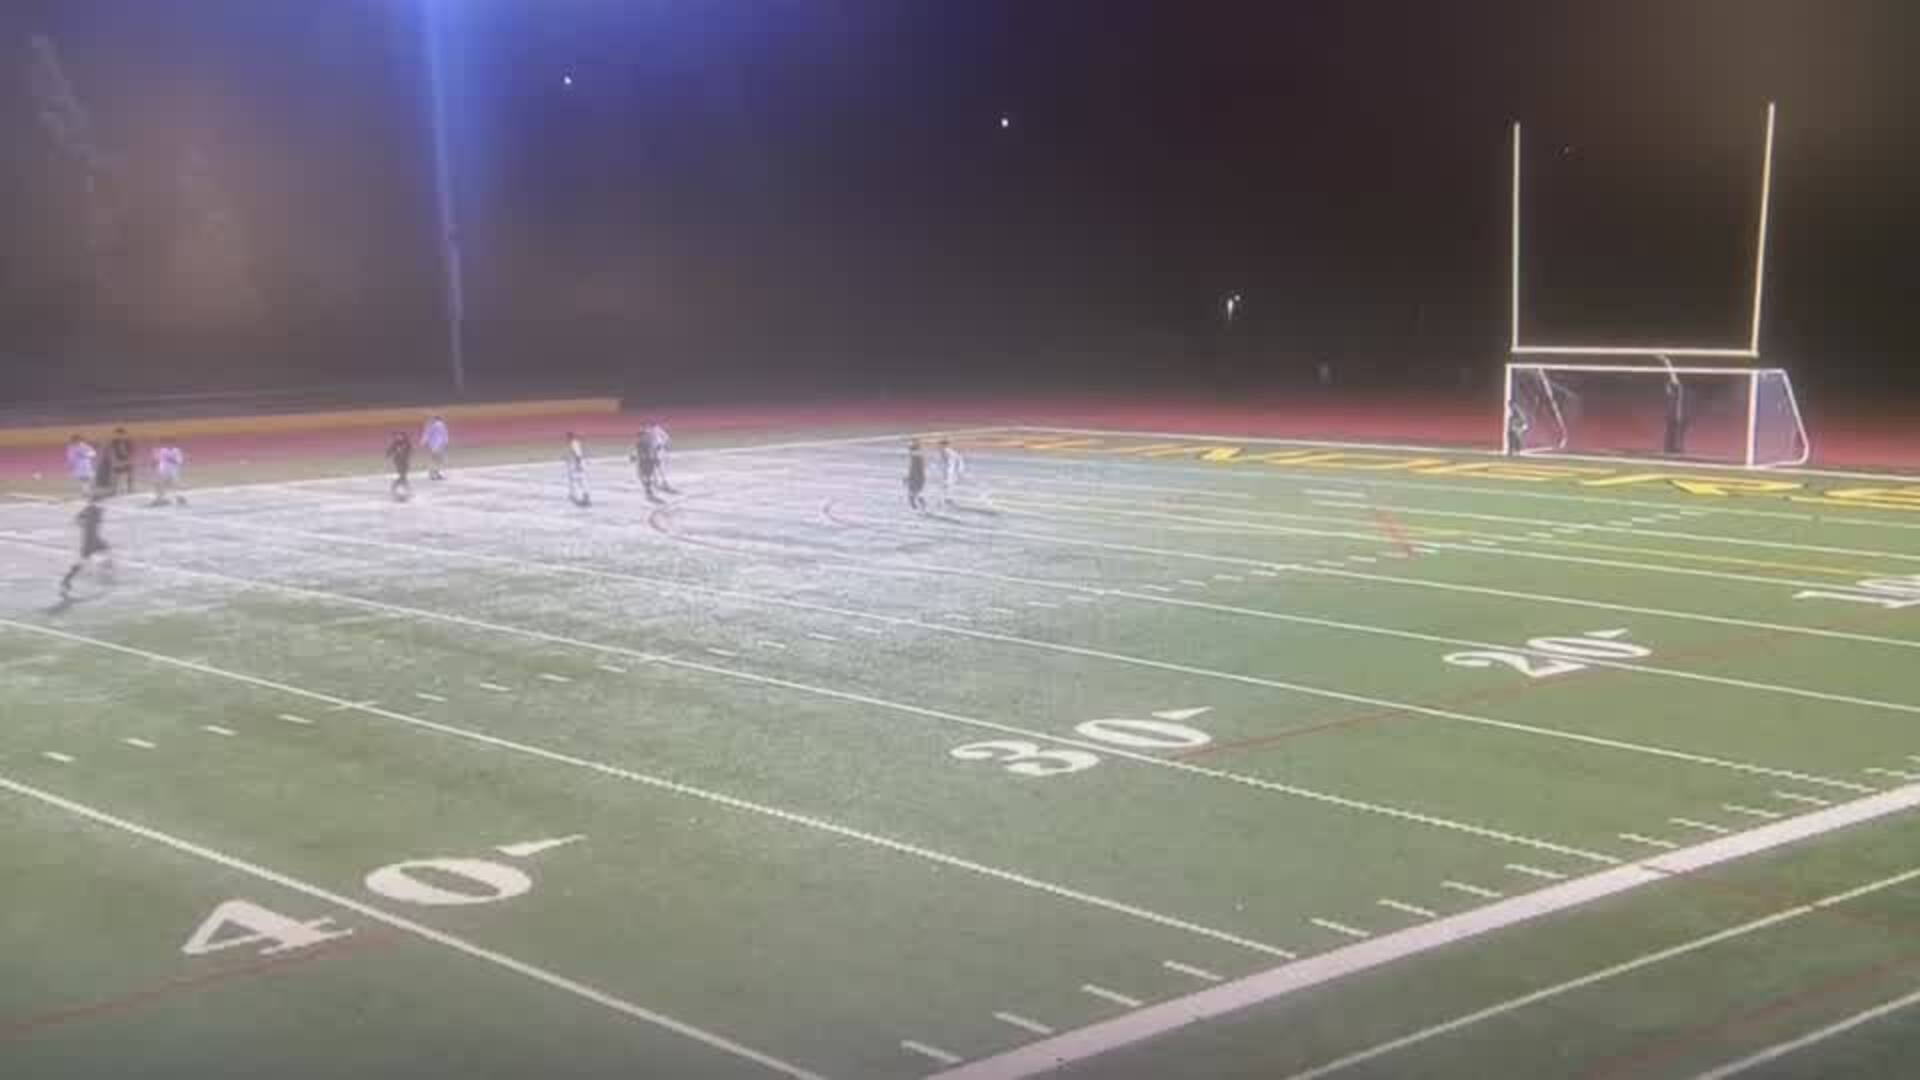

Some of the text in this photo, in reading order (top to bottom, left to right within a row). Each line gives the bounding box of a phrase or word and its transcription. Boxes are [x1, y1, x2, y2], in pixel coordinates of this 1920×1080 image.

[1442, 636, 1653, 678] 20
[949, 718, 1212, 776] 30
[182, 858, 532, 955] 40
